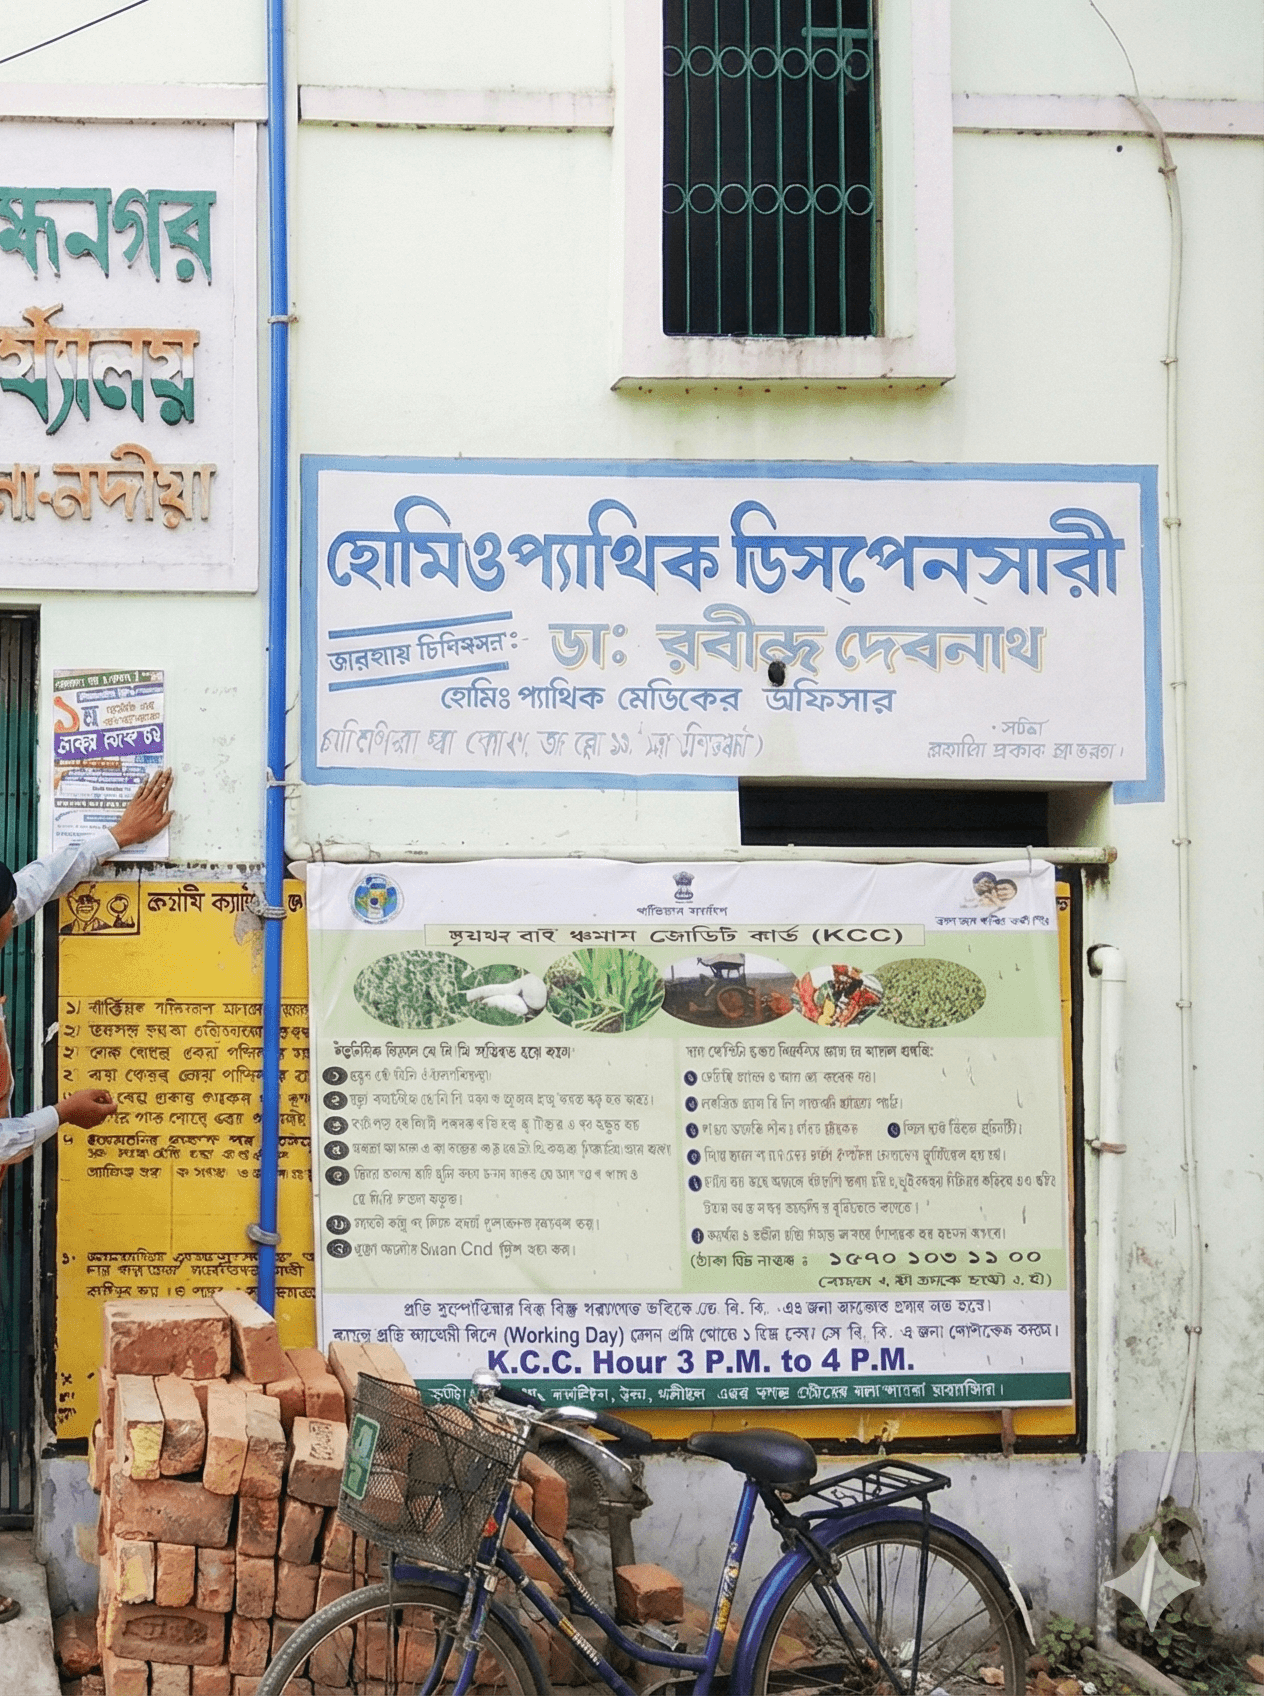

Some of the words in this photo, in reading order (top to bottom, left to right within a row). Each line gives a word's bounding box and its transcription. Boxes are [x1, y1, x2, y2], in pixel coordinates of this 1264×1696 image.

[835, 625, 1048, 675] দেবনাথ
[762, 677, 897, 714] অফিসার
[811, 928, 904, 945] (KCC)
[503, 1326, 580, 1348] (Working
[586, 1325, 625, 1348] Day)
[487, 1349, 583, 1375] K.C.C.
[593, 1349, 668, 1375] Hour
[676, 1349, 696, 1375] 3
[705, 1348, 771, 1374] P.M.
[781, 1349, 812, 1374] to
[820, 1348, 841, 1373] 4
[850, 1347, 915, 1373] P.M.
